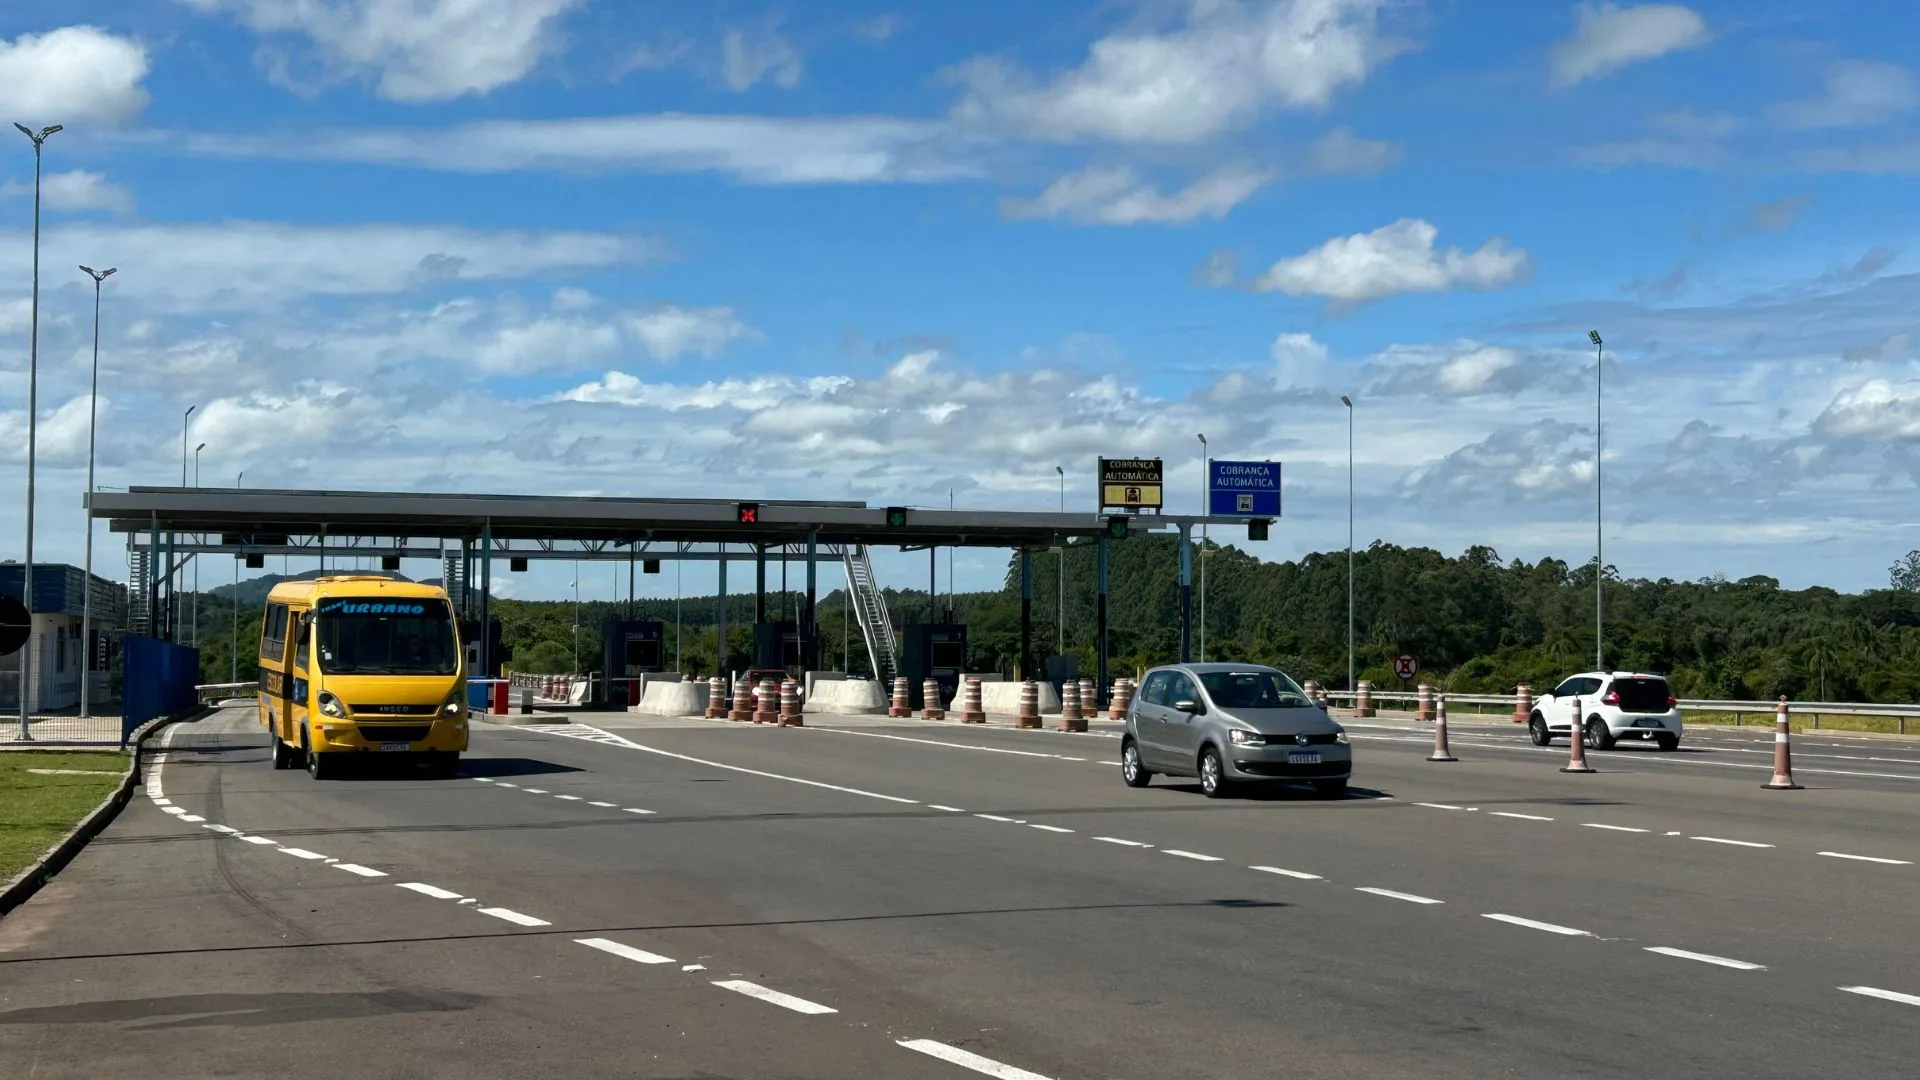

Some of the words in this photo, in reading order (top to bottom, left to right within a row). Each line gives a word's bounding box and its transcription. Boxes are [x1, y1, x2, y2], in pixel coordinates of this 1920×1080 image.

[1110, 461, 1154, 470] COBRANÇA
[1105, 471, 1159, 480] AUTOMÁTICA
[1220, 466, 1270, 476] COBRANÇA
[1216, 476, 1274, 487] AUTOMÁTICA
[342, 604, 425, 614] URBANO
